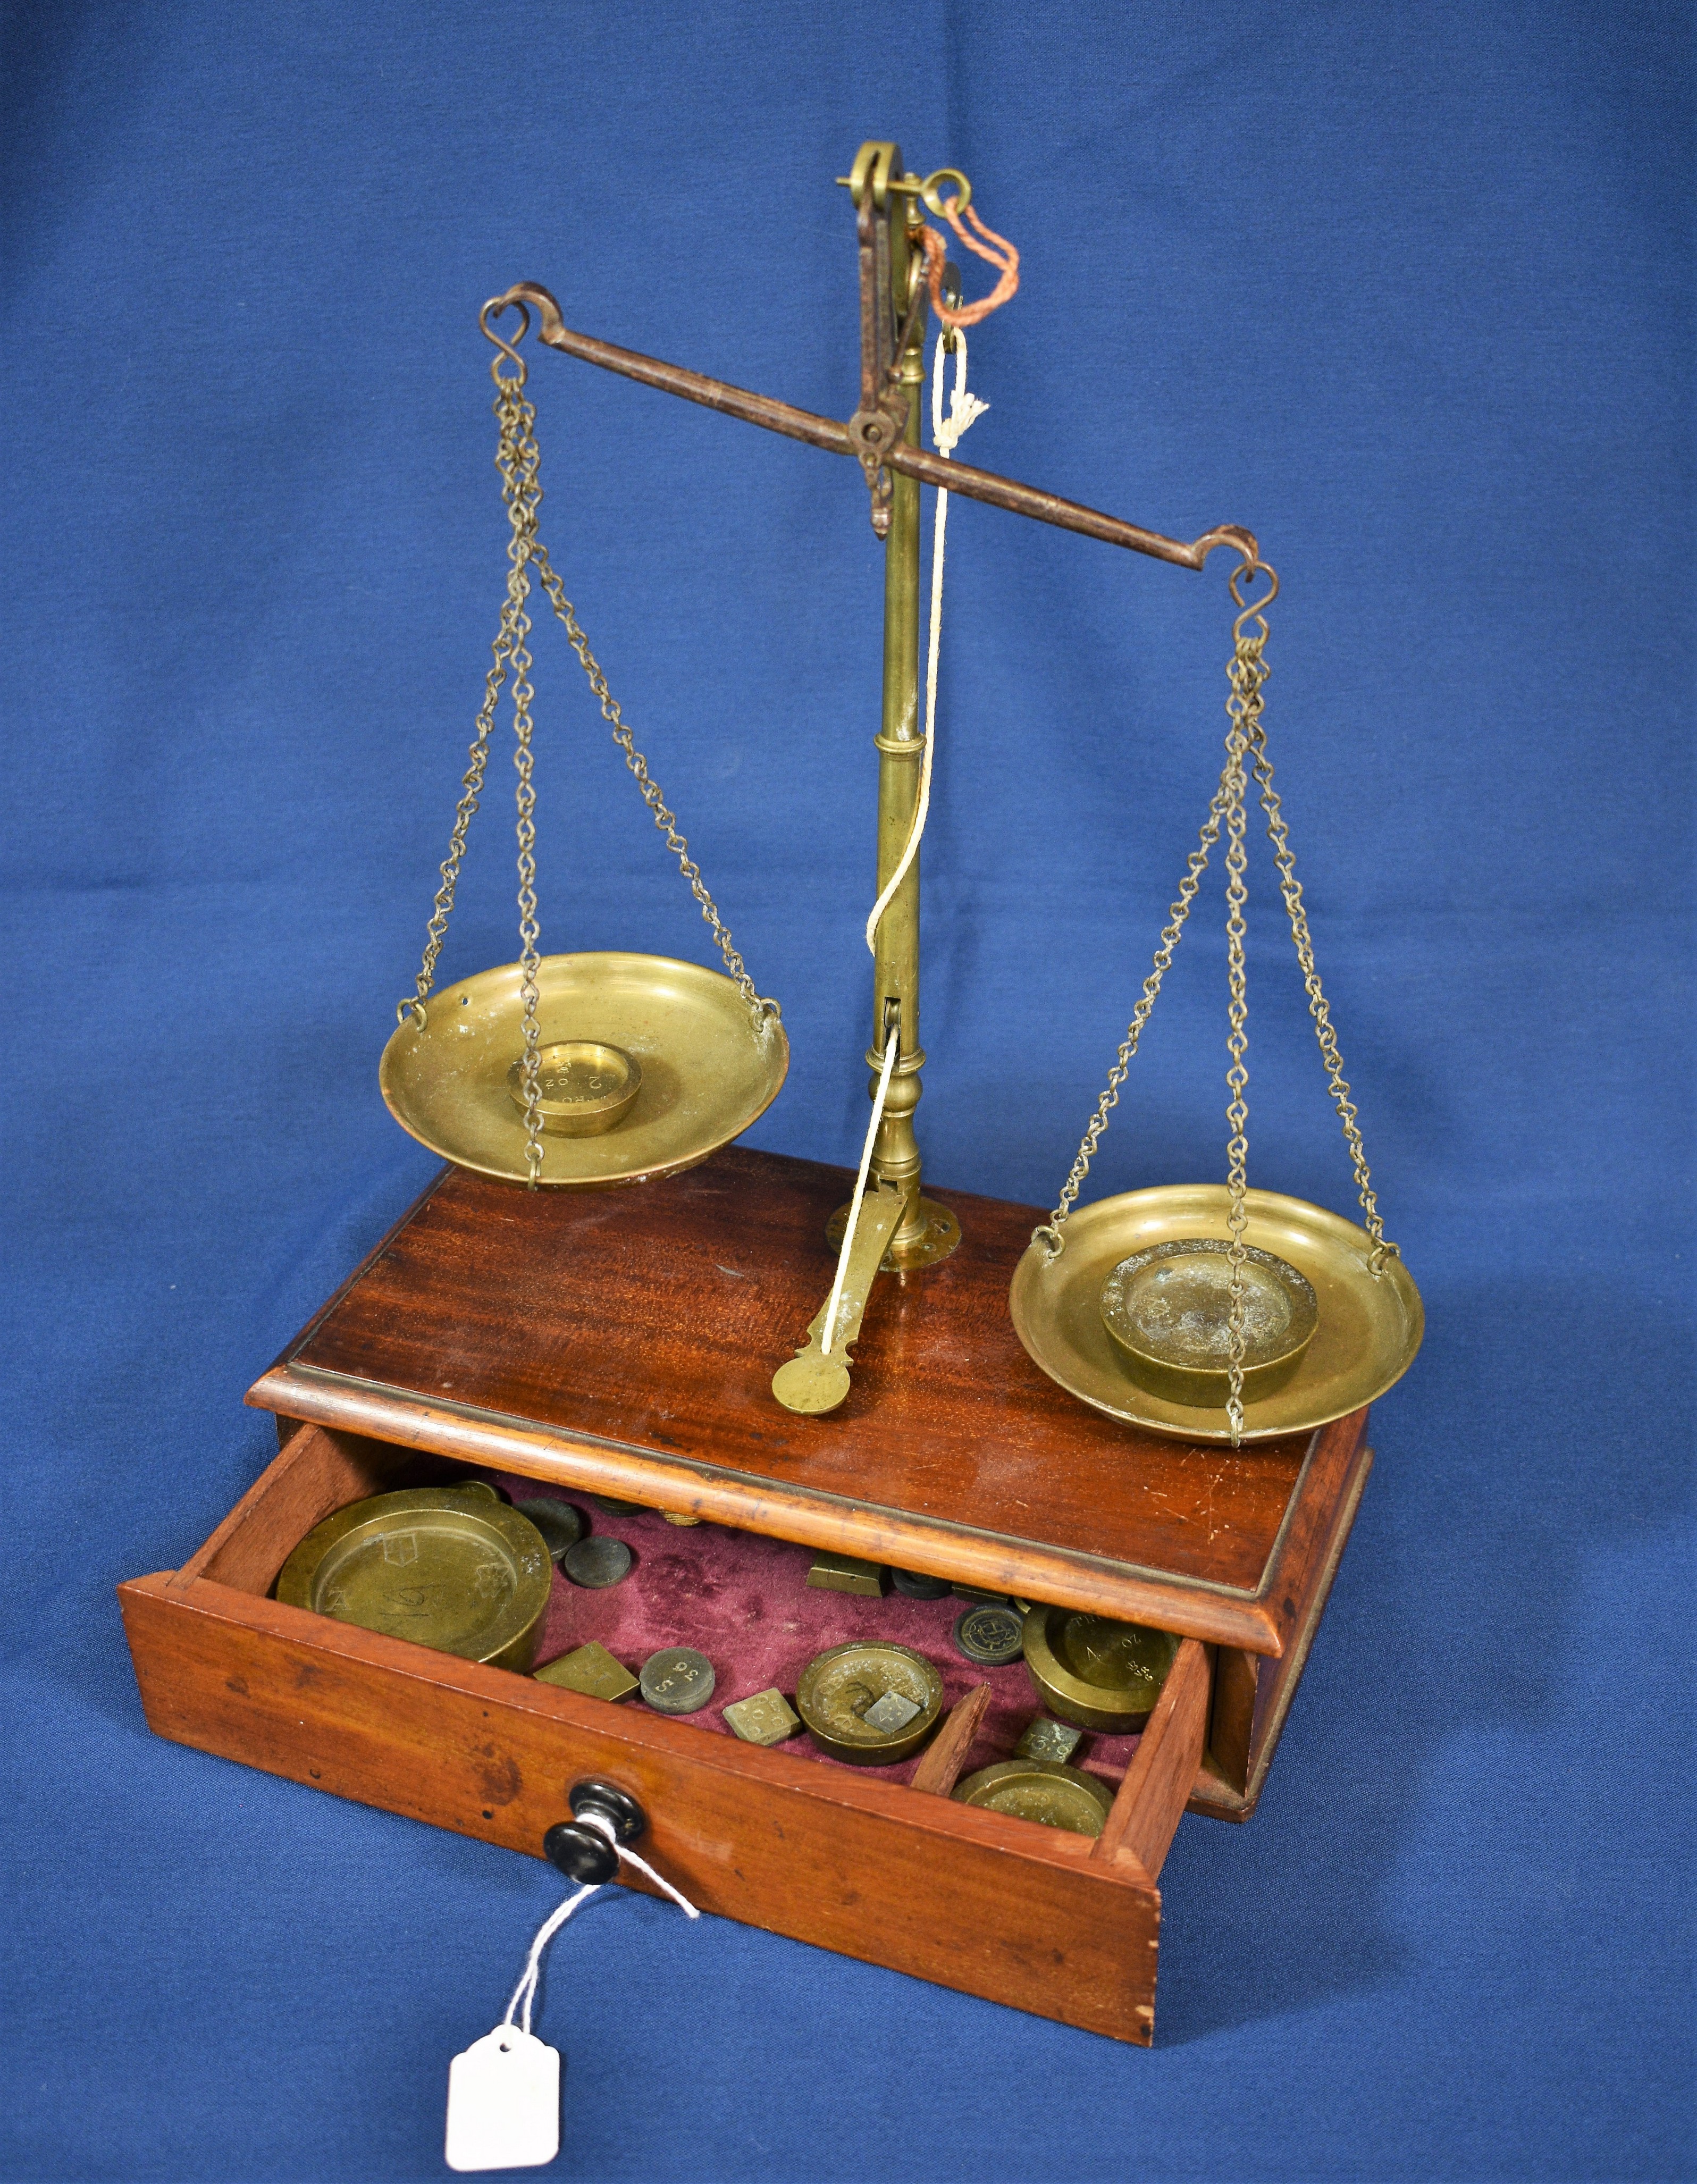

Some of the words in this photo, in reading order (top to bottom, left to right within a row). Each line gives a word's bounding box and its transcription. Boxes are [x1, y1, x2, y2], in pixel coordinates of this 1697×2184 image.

[589, 1076, 602, 1089] 2
[1122, 1634, 1141, 1648] OZ
[672, 1661, 699, 1682] 36
